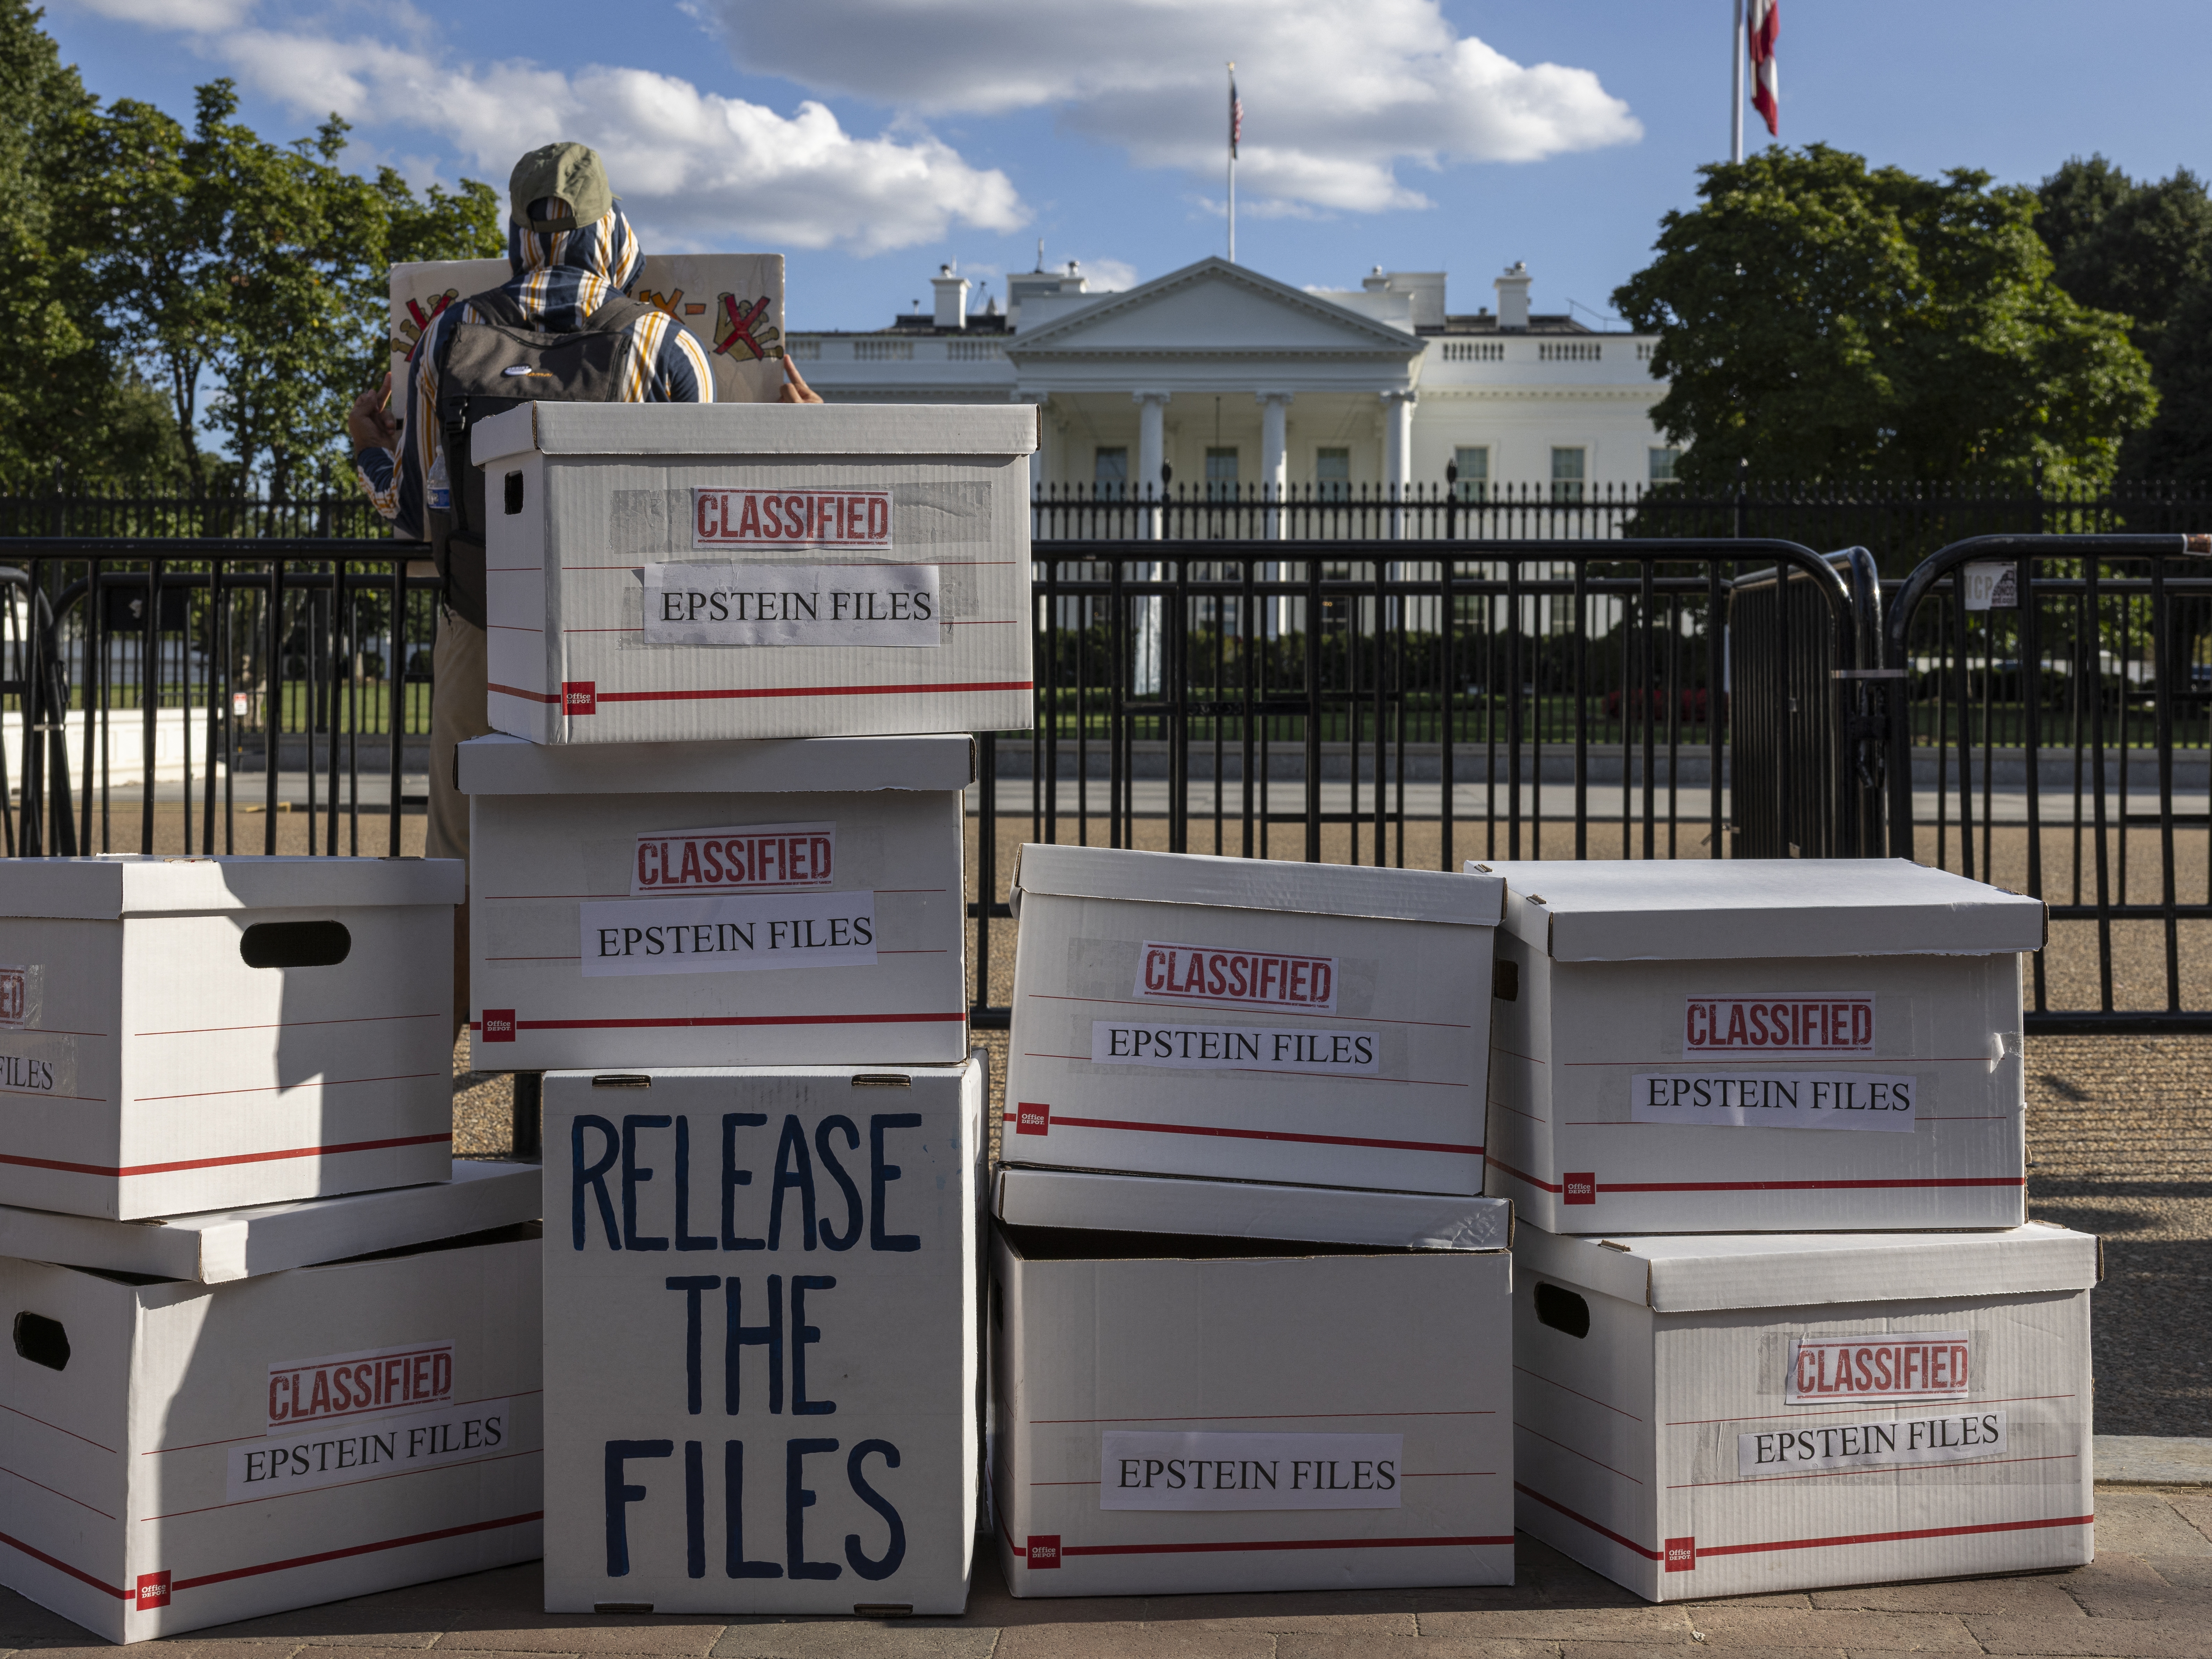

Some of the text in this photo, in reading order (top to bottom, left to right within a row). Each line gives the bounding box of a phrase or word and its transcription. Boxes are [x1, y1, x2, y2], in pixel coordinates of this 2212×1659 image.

[697, 495, 889, 539] CLASSIFIED
[660, 592, 931, 621] EPSTEIN FILES
[638, 838, 831, 885] CLASSIFIED
[597, 917, 872, 957] EPSTEIN FILES
[1145, 950, 1331, 1002] CLASSIFIED
[1108, 1029, 1372, 1064] EPSTEIN FILES
[1687, 1004, 1872, 1046] CLASSIFIED
[1647, 1079, 1910, 1111] EPSTEIN FILES
[572, 1113, 922, 1251] RELEASE
[666, 1274, 837, 1416] THE
[269, 1353, 452, 1421] CLASSIFIED
[1797, 1345, 1968, 1393] CLASSIFIED
[243, 1417, 502, 1483] EPSTEIN FILES
[1754, 1414, 1999, 1464] EPSTEIN FILES
[1117, 1459, 1395, 1490] EPSTEIN FILES
[605, 1438, 907, 1581] FILES
[142, 1585, 166, 1593] Office
